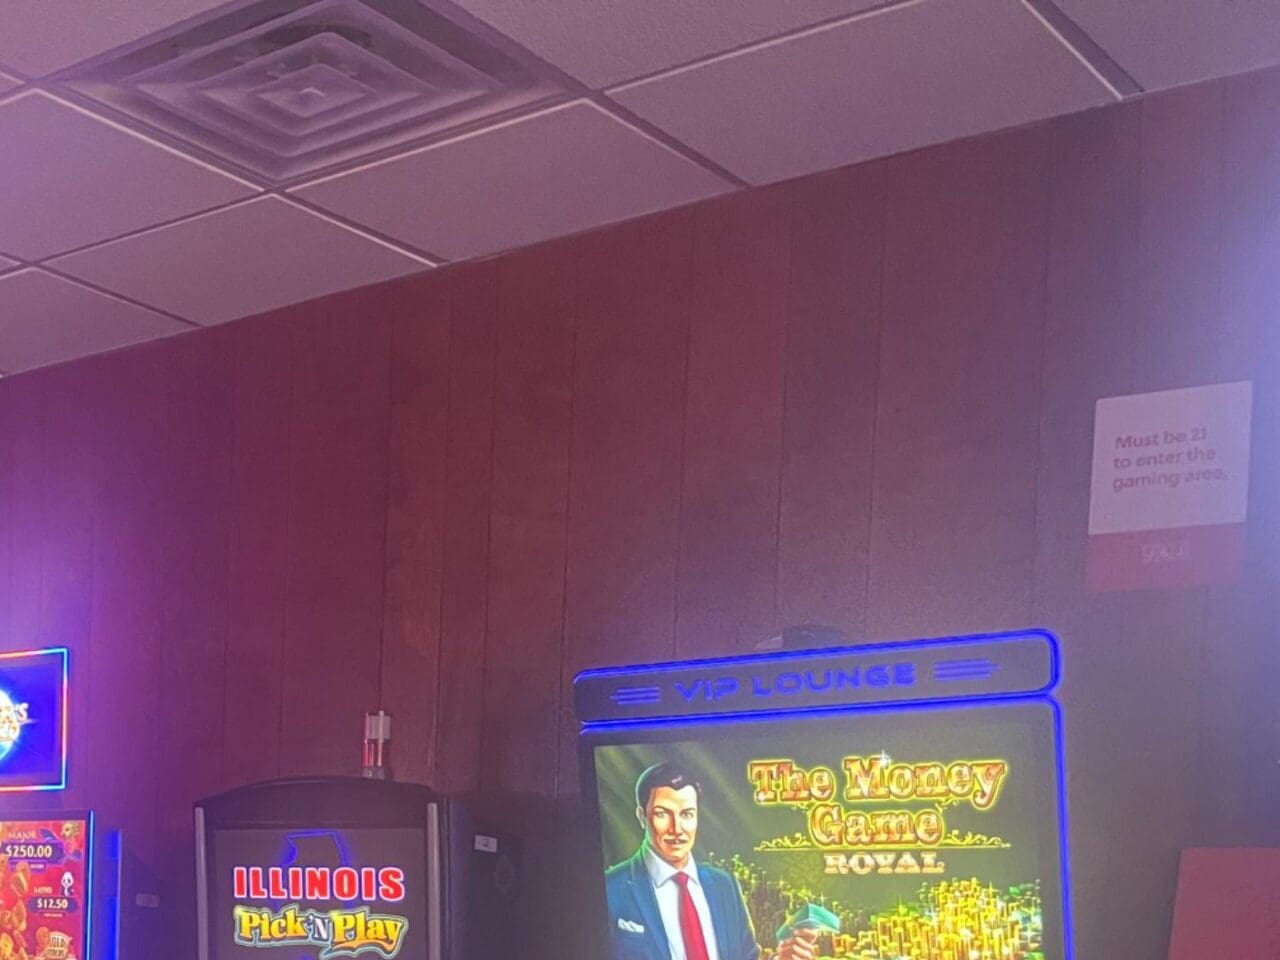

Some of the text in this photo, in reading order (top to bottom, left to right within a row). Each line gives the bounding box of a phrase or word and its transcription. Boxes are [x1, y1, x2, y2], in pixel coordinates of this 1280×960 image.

[1114, 427, 1207, 450] Must be 21
[1113, 446, 1217, 470] to enter the
[1112, 471, 1181, 493] gaming
[674, 662, 918, 702] VIP LOUNGE
[748, 751, 1006, 811] The Money
[807, 804, 945, 848] Game
[4, 844, 53, 858] $250.00
[823, 851, 945, 875] ROYAL
[233, 866, 405, 902] ILLINOIS
[37, 897, 69, 910] $12.50
[238, 904, 307, 941] Pick
[328, 906, 406, 952] Play
